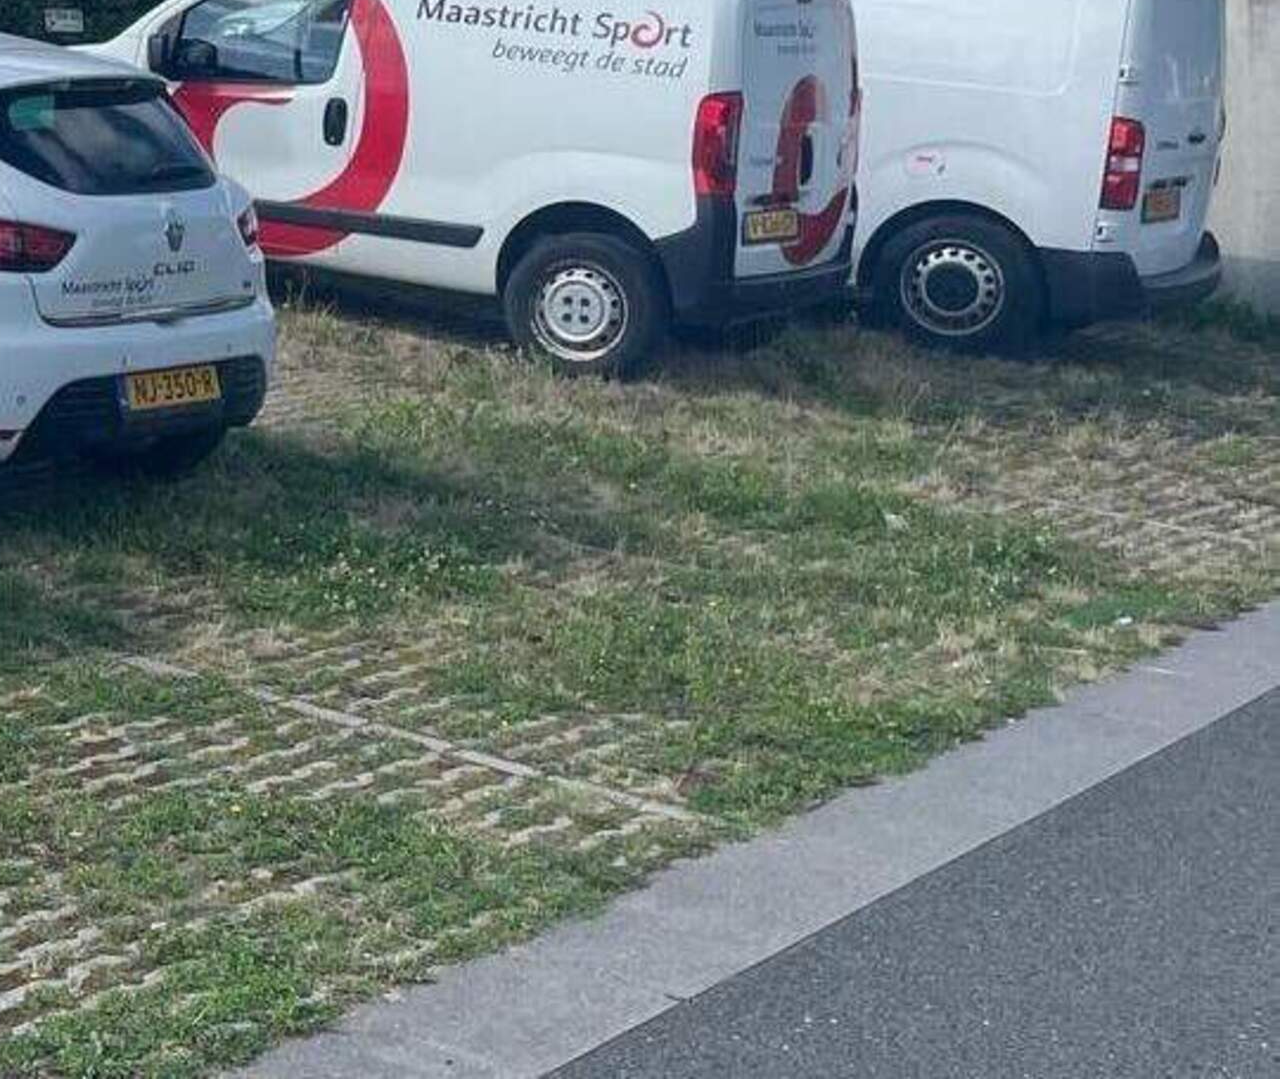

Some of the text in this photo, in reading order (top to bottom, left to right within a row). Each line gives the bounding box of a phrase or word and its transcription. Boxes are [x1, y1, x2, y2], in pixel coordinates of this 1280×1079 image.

[592, 11, 692, 48] Sport
[491, 38, 689, 79] beweegt de stad
